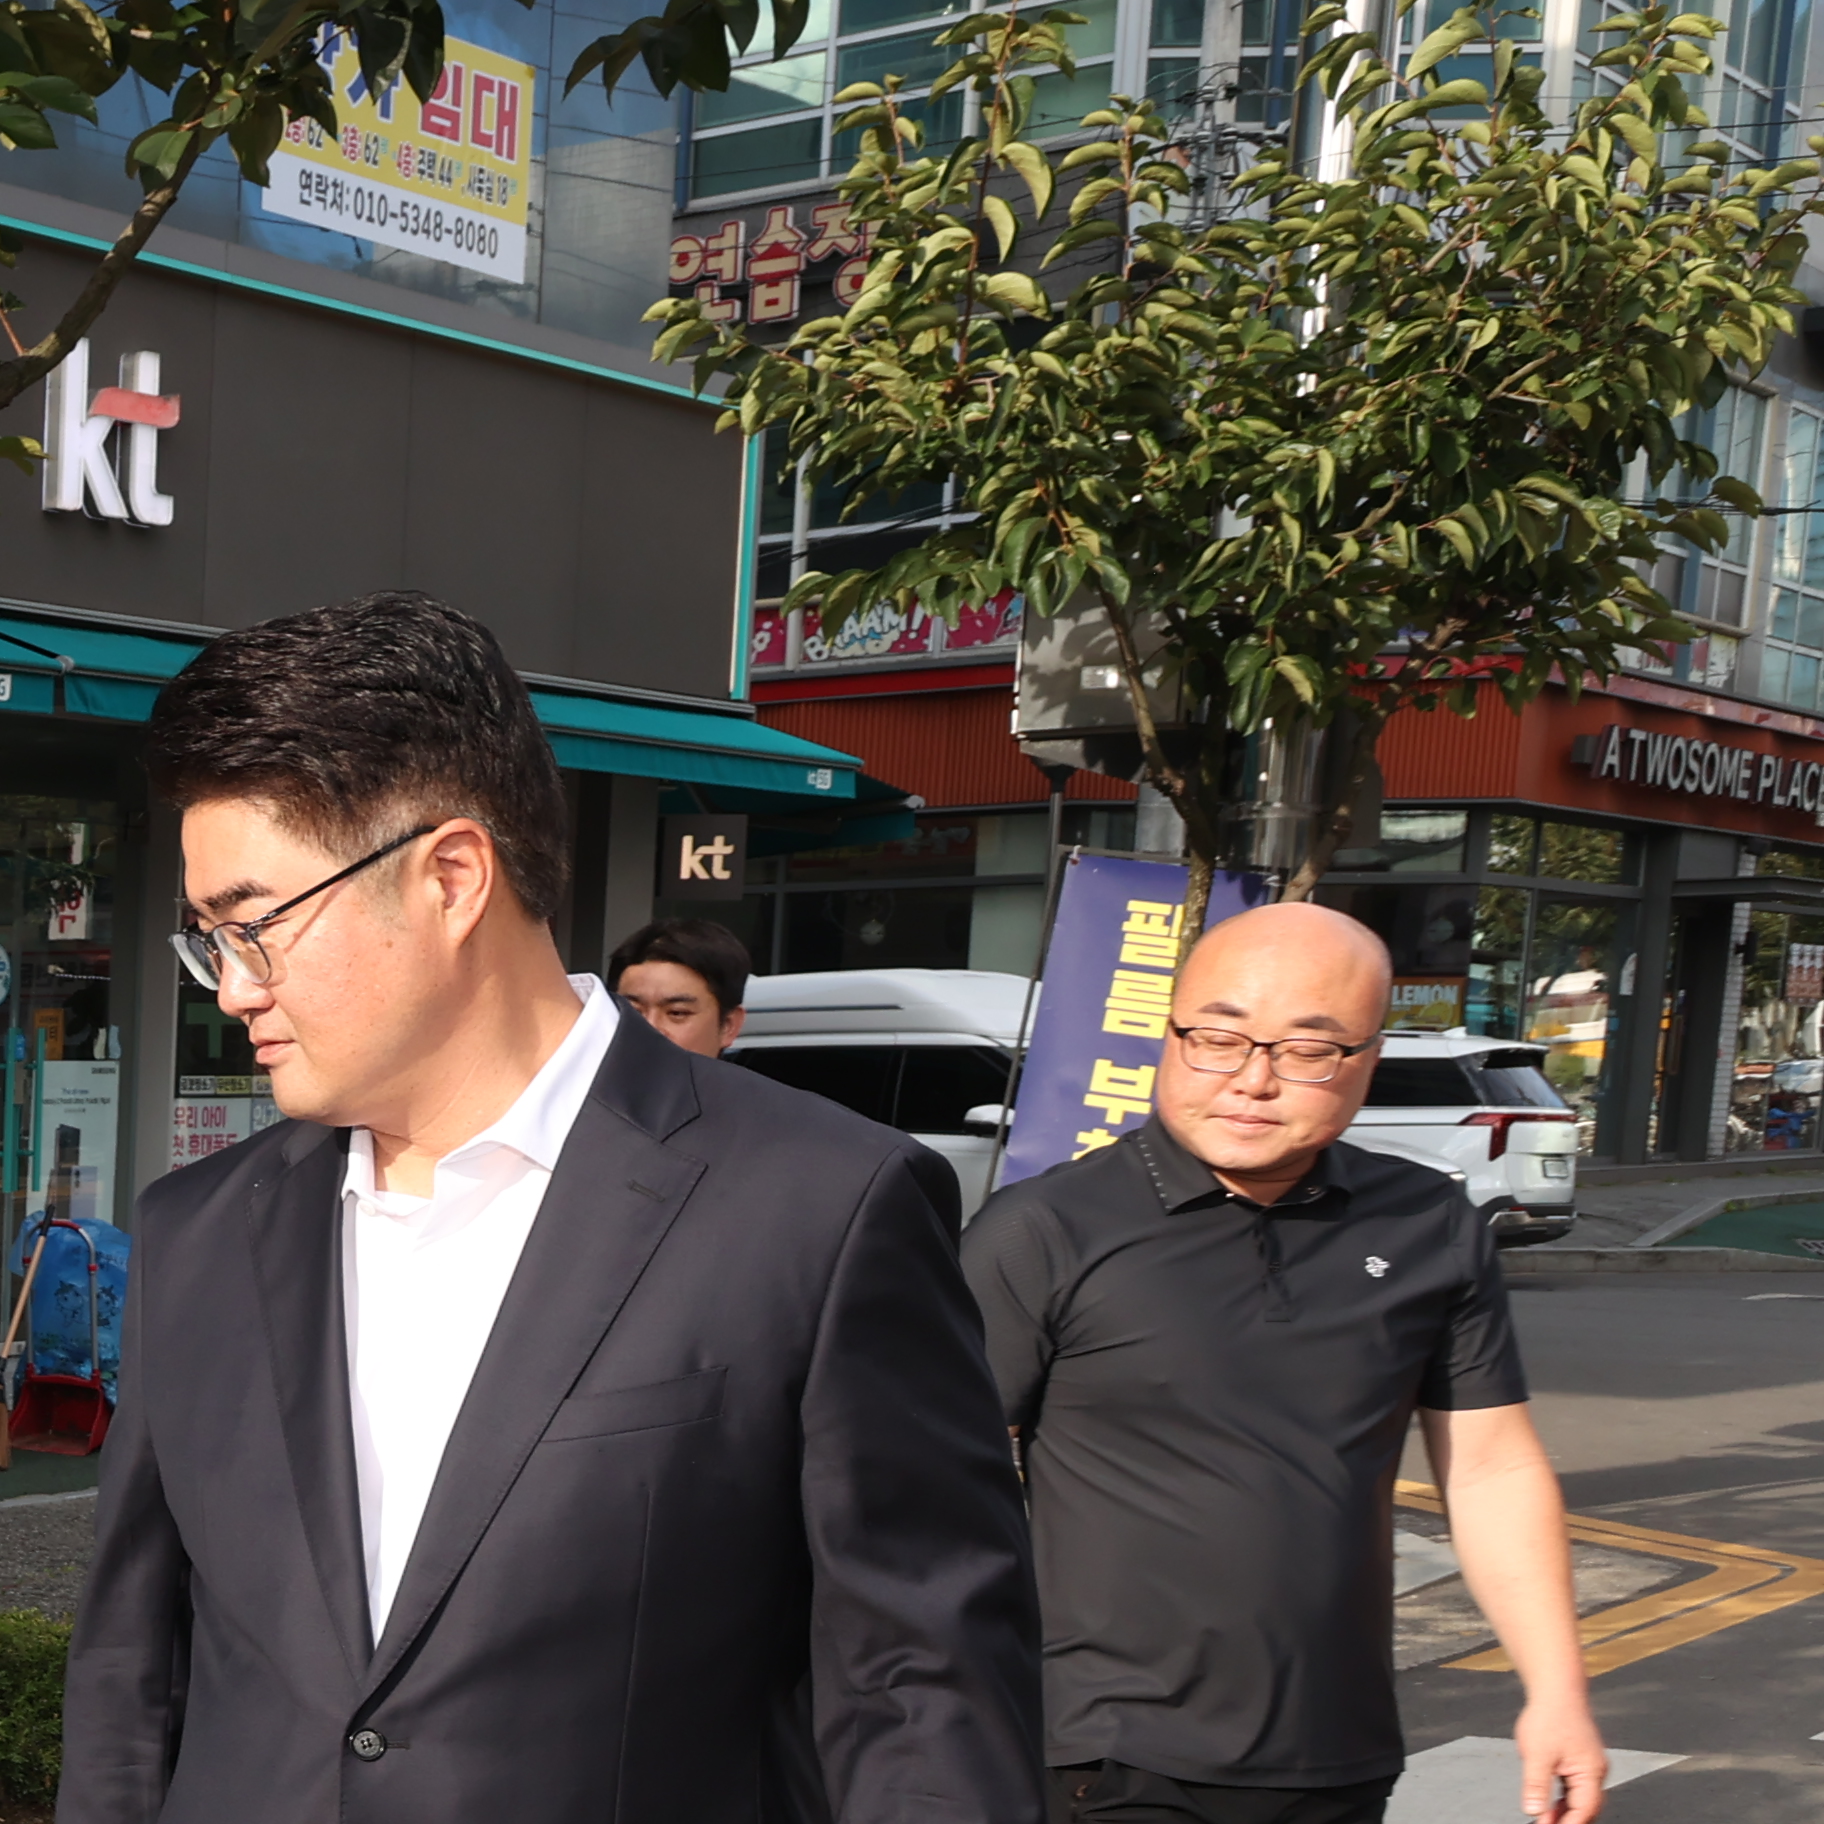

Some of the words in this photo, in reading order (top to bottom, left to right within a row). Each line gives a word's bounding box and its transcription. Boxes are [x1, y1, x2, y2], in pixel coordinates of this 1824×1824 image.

[299, 167, 350, 217] 연락처:
[353, 187, 499, 259] 010-5348-8080
[42, 336, 180, 528] kt
[1600, 724, 1621, 779] A
[1629, 728, 1755, 800] TWOSOME
[679, 835, 735, 880] kt
[1391, 984, 1460, 1006] LEMON
[173, 1106, 198, 1129] 우리
[202, 1105, 227, 1128] 아이
